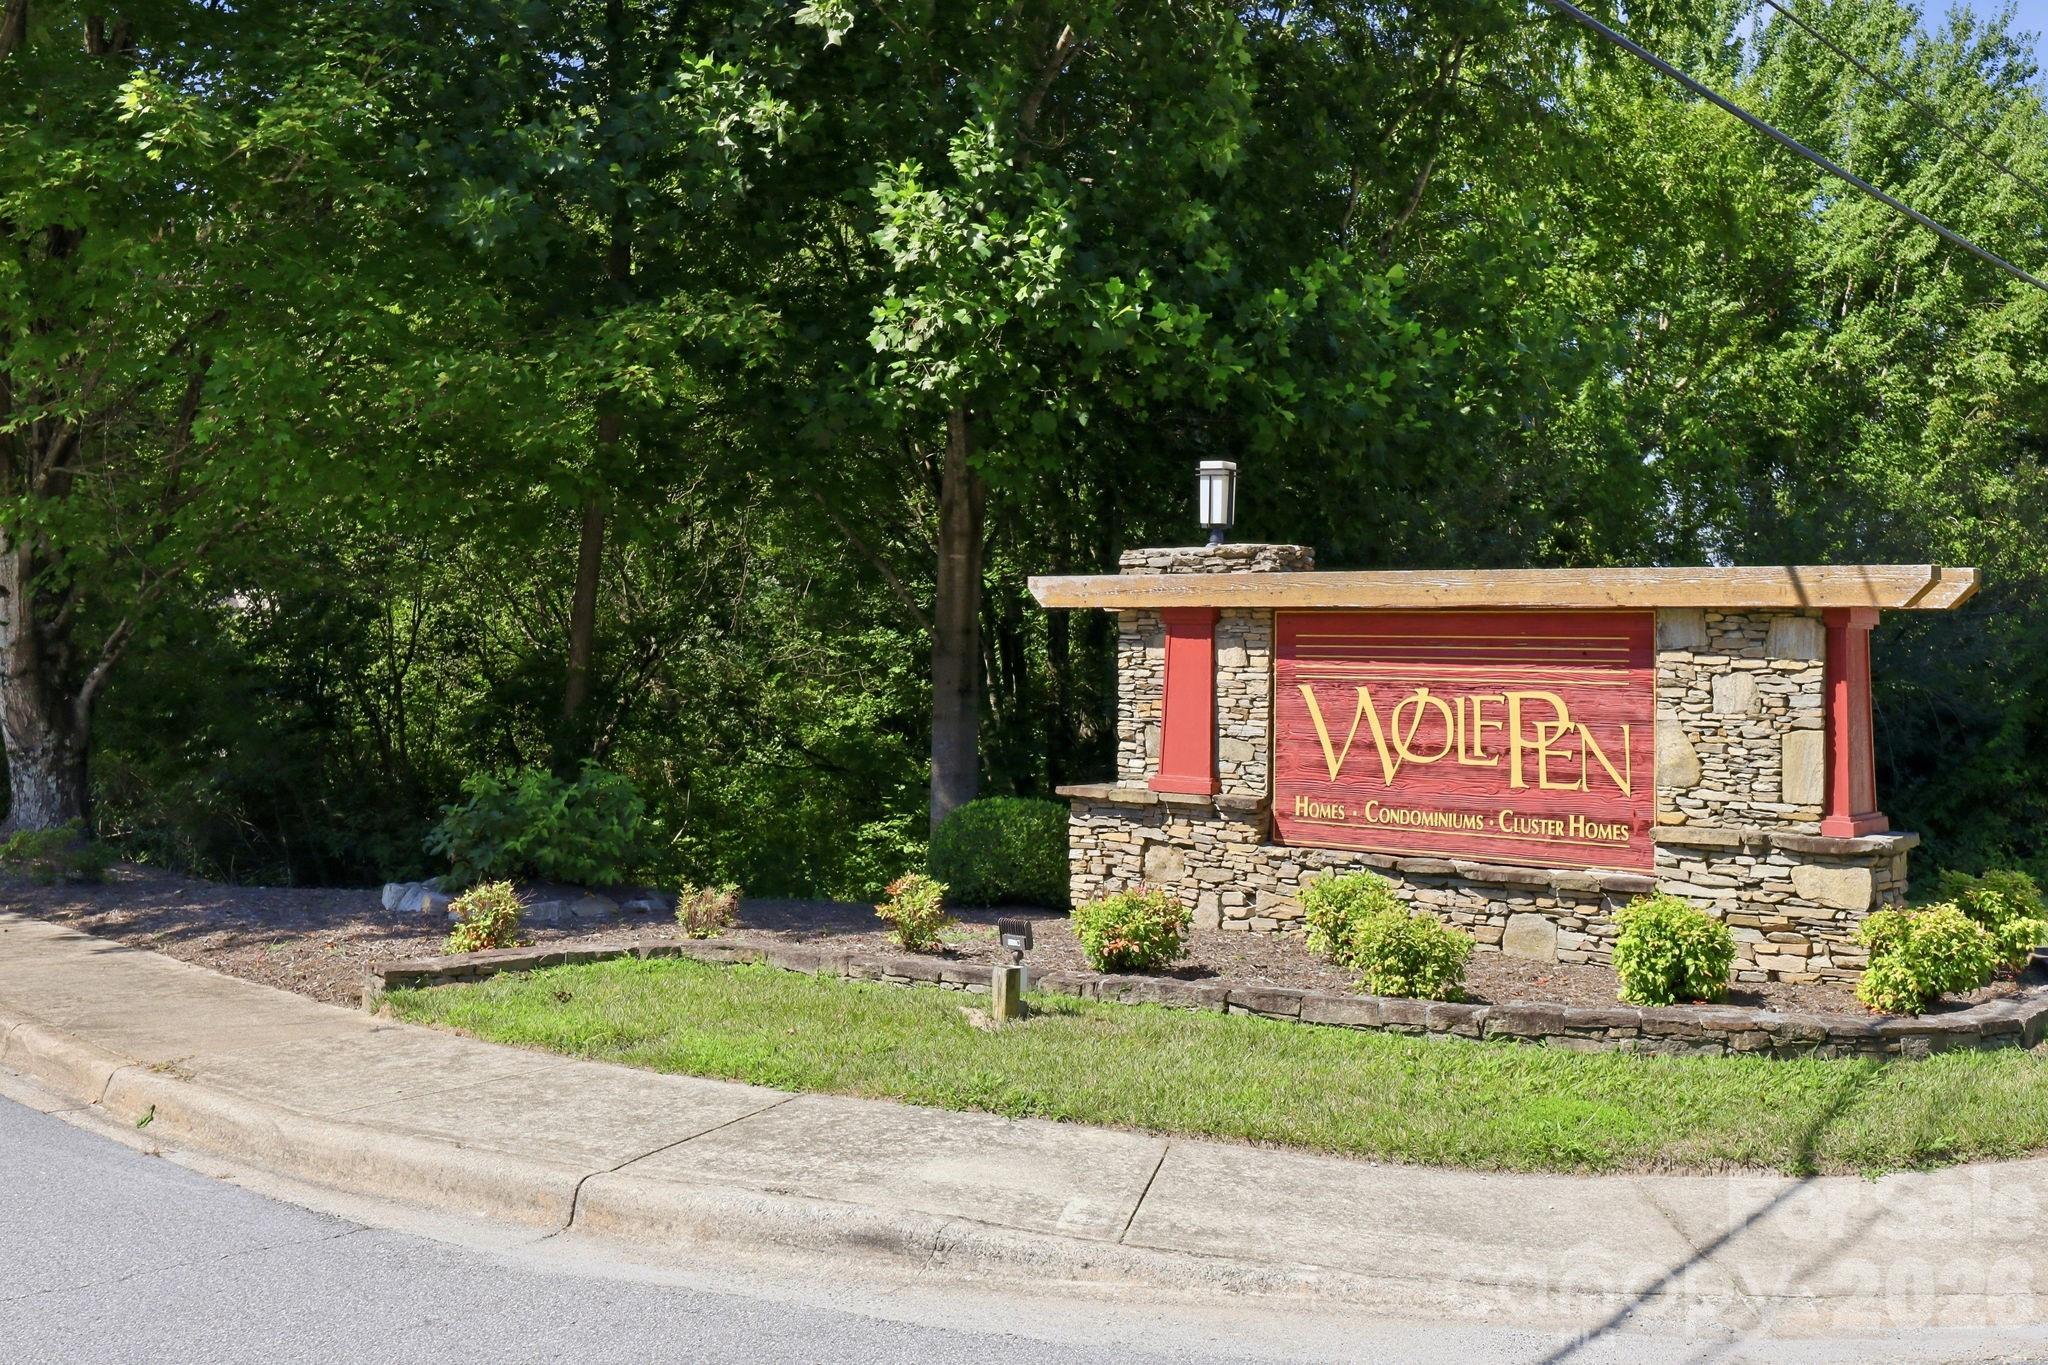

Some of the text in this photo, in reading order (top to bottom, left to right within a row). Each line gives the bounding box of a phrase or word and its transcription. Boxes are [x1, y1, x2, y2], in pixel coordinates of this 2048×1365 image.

[1295, 795, 1630, 842] HOMES CONDOMINIUMS CLUSTER HOMES
